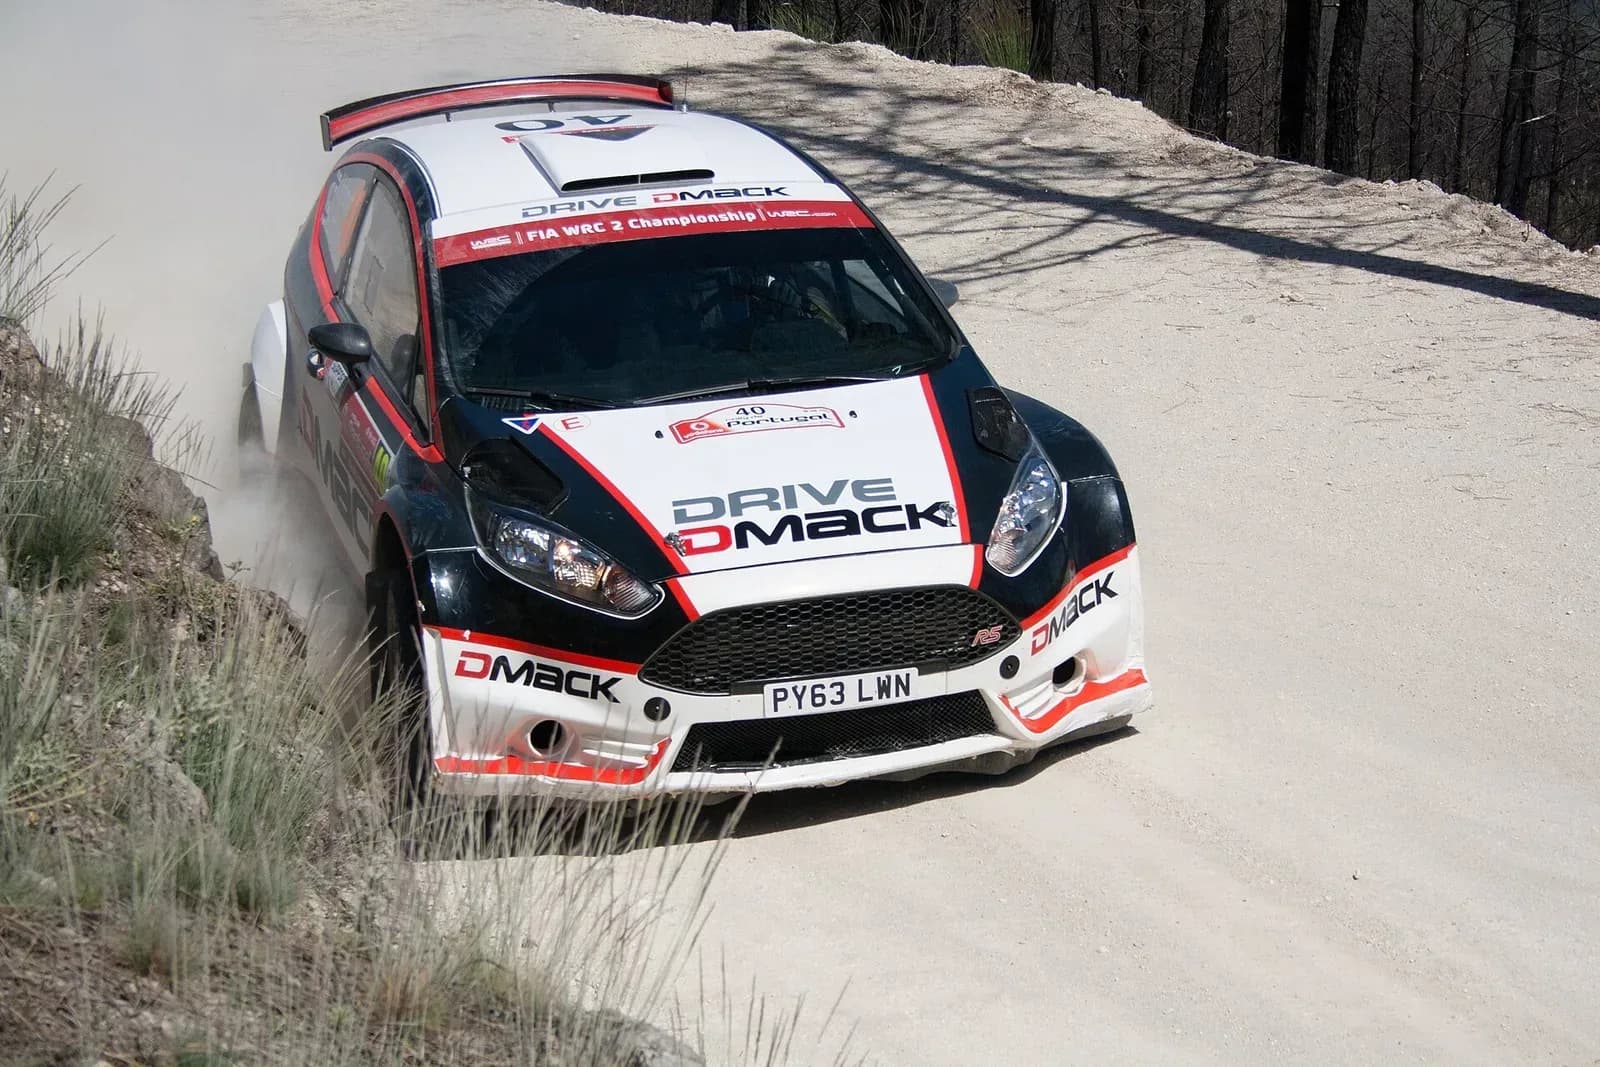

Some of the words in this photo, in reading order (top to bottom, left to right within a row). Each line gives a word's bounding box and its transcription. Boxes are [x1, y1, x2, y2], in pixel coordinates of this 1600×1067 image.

[495, 114, 632, 131] 40
[522, 194, 637, 219] DRIVE
[526, 229, 560, 242] FIA
[562, 222, 606, 238] WRC
[611, 220, 624, 231] 2
[628, 208, 757, 230] Championship
[735, 406, 766, 416] 40
[560, 416, 585, 430] E
[672, 478, 896, 524] DRIVE
[971, 625, 1003, 646] RS
[772, 681, 846, 713] PY63
[857, 672, 911, 702] LWN
